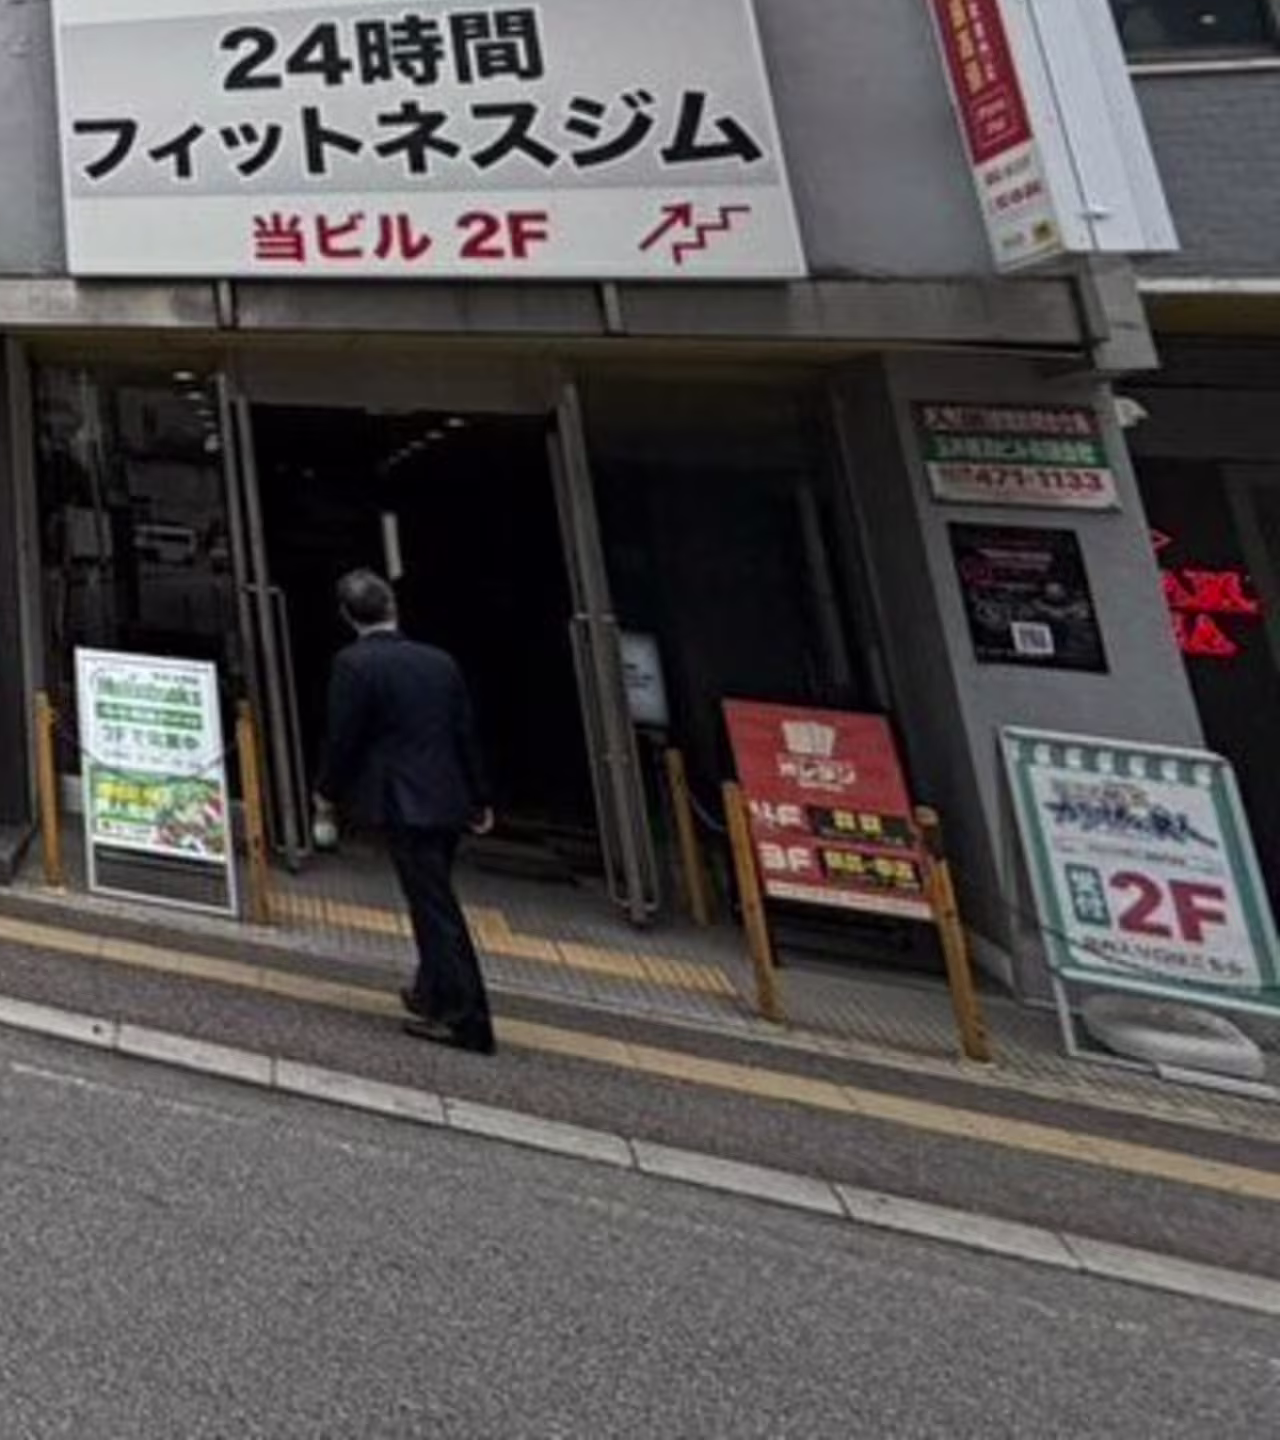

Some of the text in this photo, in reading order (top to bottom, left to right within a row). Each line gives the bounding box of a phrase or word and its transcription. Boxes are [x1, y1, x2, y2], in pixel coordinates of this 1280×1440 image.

[218, 9, 547, 92] 24時間
[72, 90, 765, 182] フィットネスジム
[252, 212, 550, 265] 当ビル 2F
[1108, 870, 1227, 944] 2F
